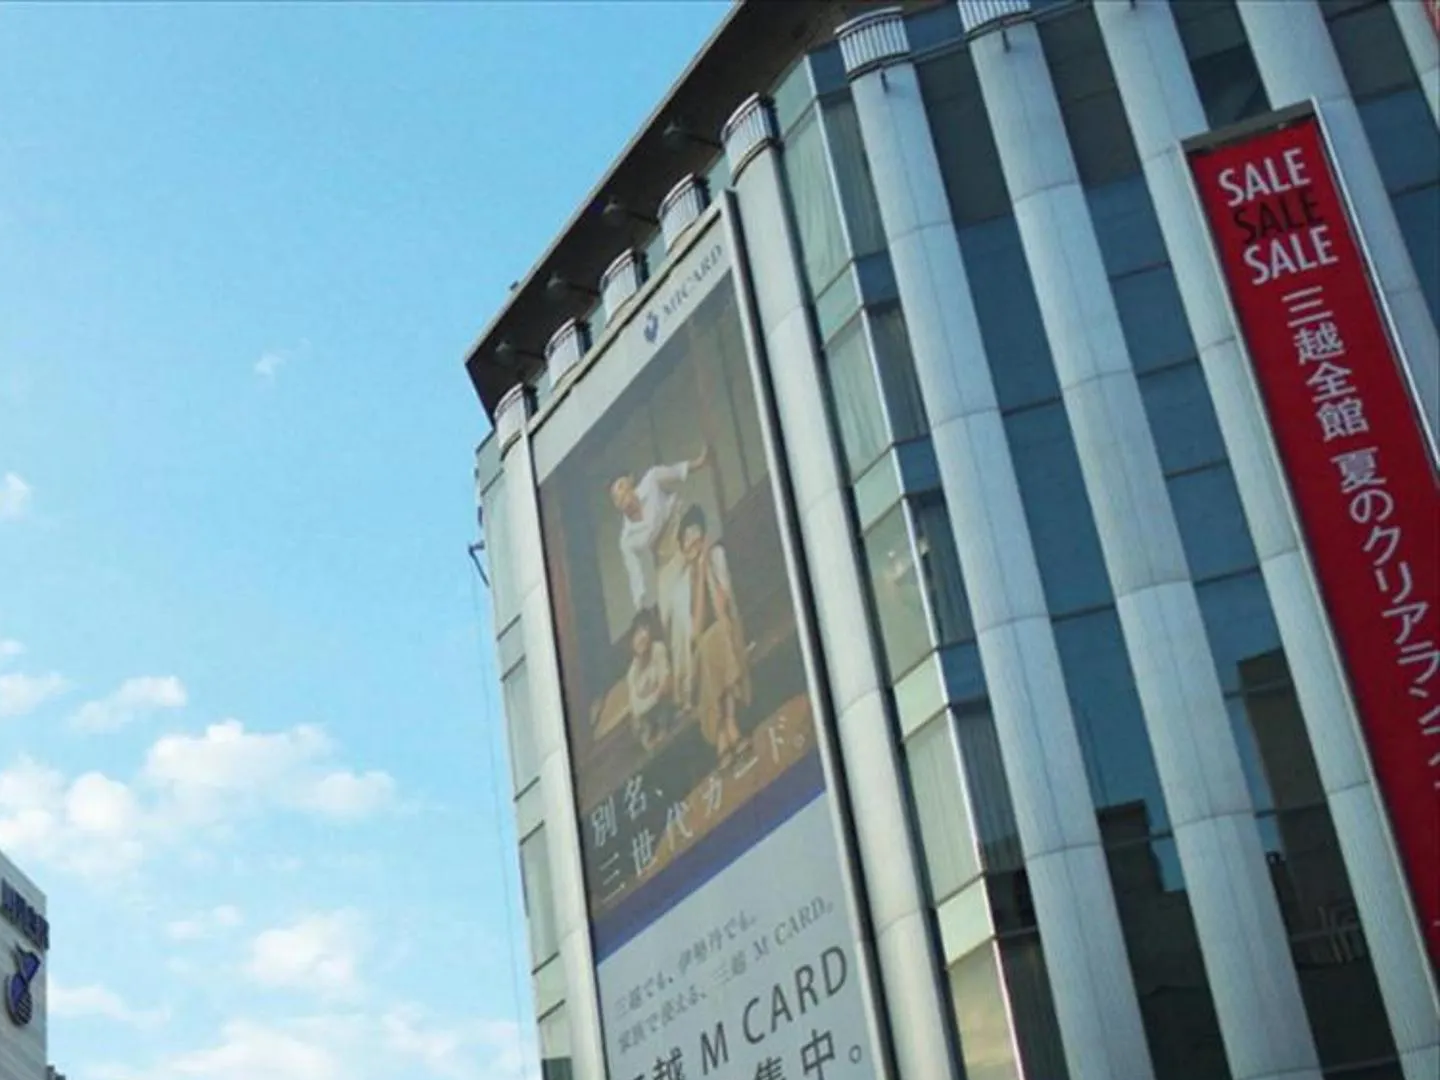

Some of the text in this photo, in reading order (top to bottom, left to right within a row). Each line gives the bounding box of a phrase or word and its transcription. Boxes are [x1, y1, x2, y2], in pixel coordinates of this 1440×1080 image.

[1218, 147, 1312, 208] SALE
[1232, 191, 1326, 246] SALE
[1243, 224, 1340, 286] SALE
[1281, 285, 1371, 442] 三越全館
[699, 1021, 729, 1076] M
[742, 946, 848, 1045] CARD
